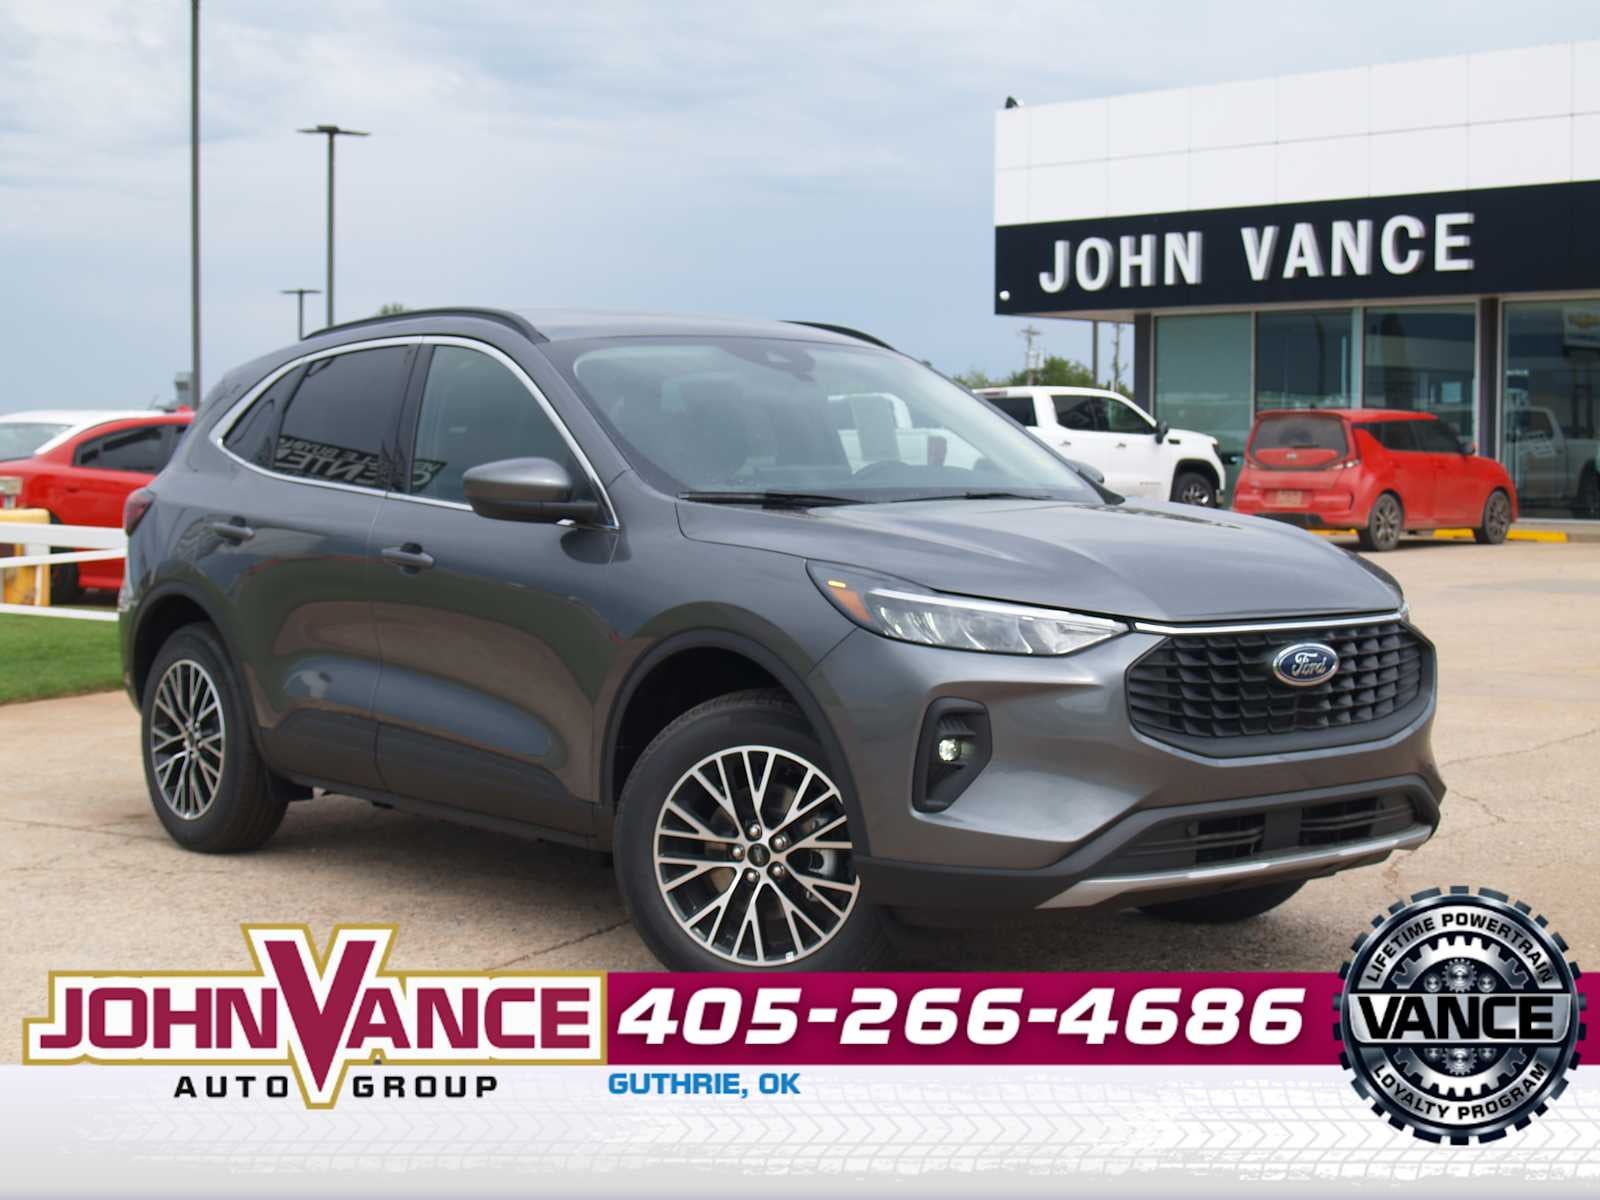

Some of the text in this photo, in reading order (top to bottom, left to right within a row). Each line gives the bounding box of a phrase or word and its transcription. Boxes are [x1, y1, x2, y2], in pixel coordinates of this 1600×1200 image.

[1038, 211, 1475, 294] JOHN VANCE
[1291, 651, 1328, 677] Ford
